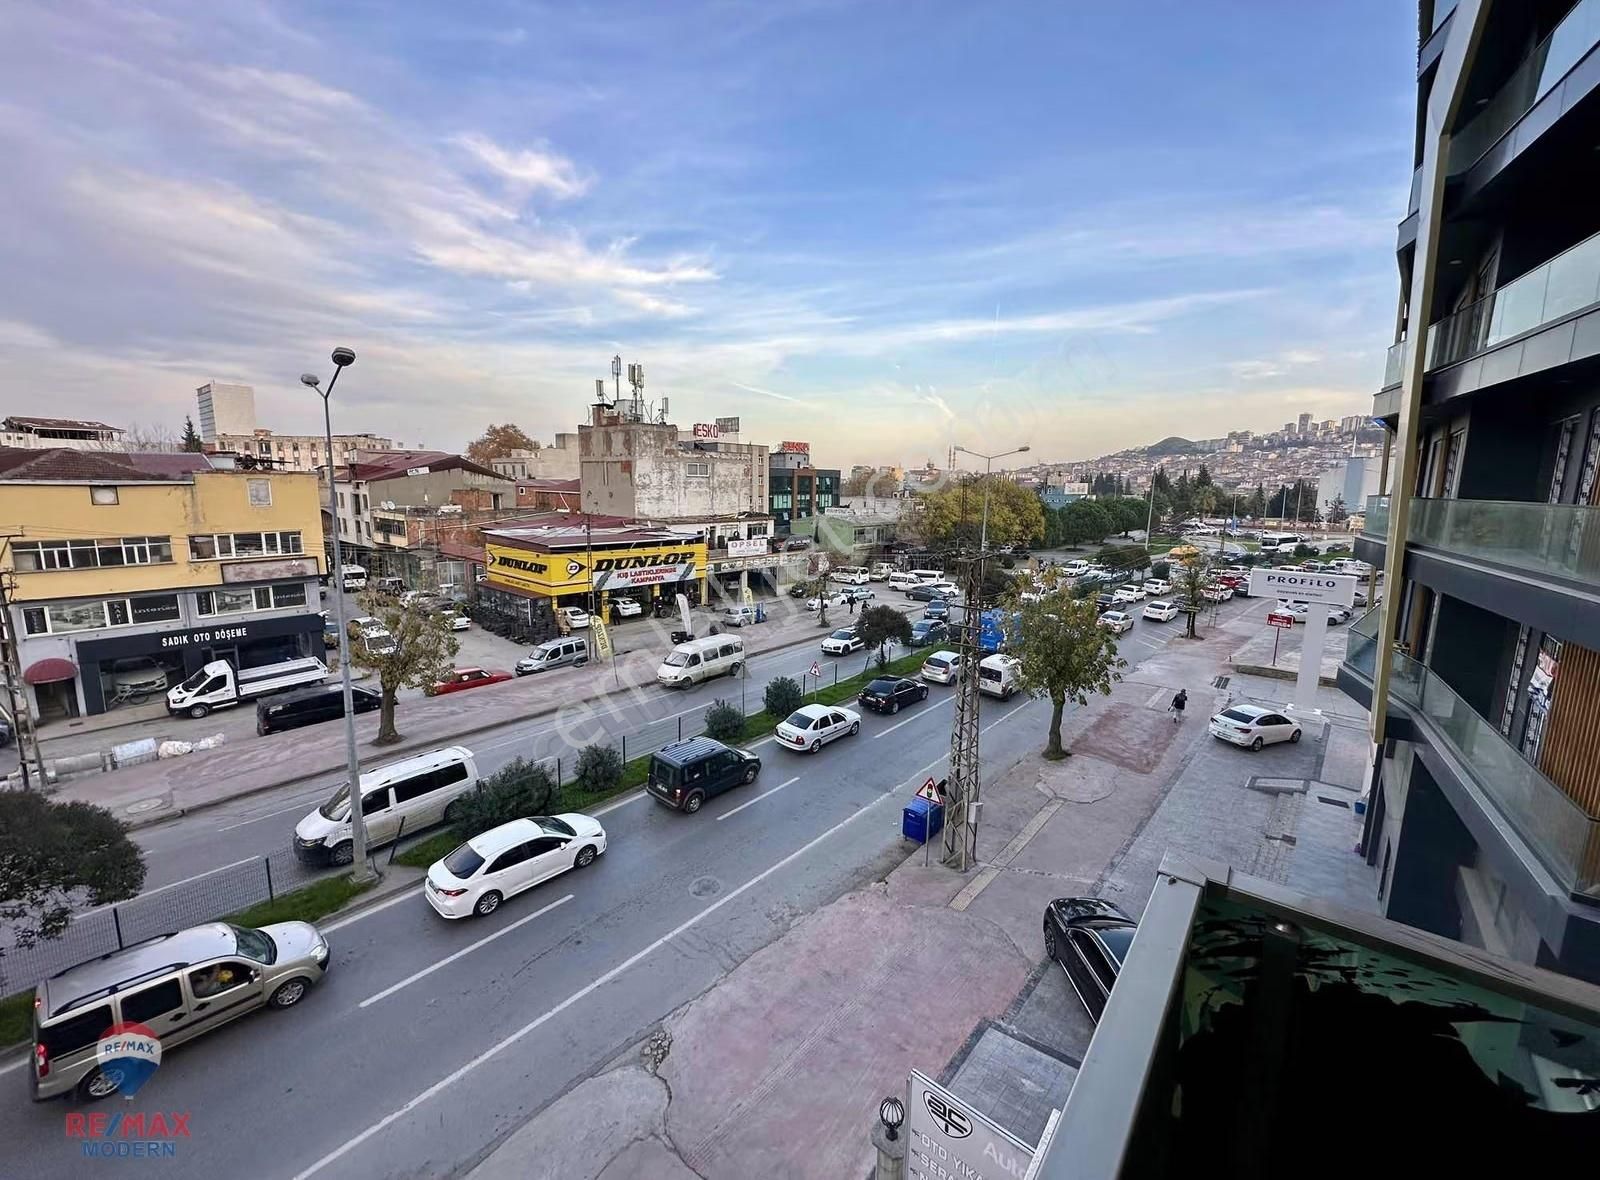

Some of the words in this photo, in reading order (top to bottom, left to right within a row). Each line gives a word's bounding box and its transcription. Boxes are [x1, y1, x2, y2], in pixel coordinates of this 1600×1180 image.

[731, 540, 765, 549] OPSEL
[498, 556, 548, 574] DUNLOP
[592, 552, 696, 572] DUNLOP
[162, 635, 189, 647] SADIK
[193, 631, 211, 643] OTO
[215, 627, 248, 641] DÖŞEME
[921, 1134, 947, 1161] OTO
